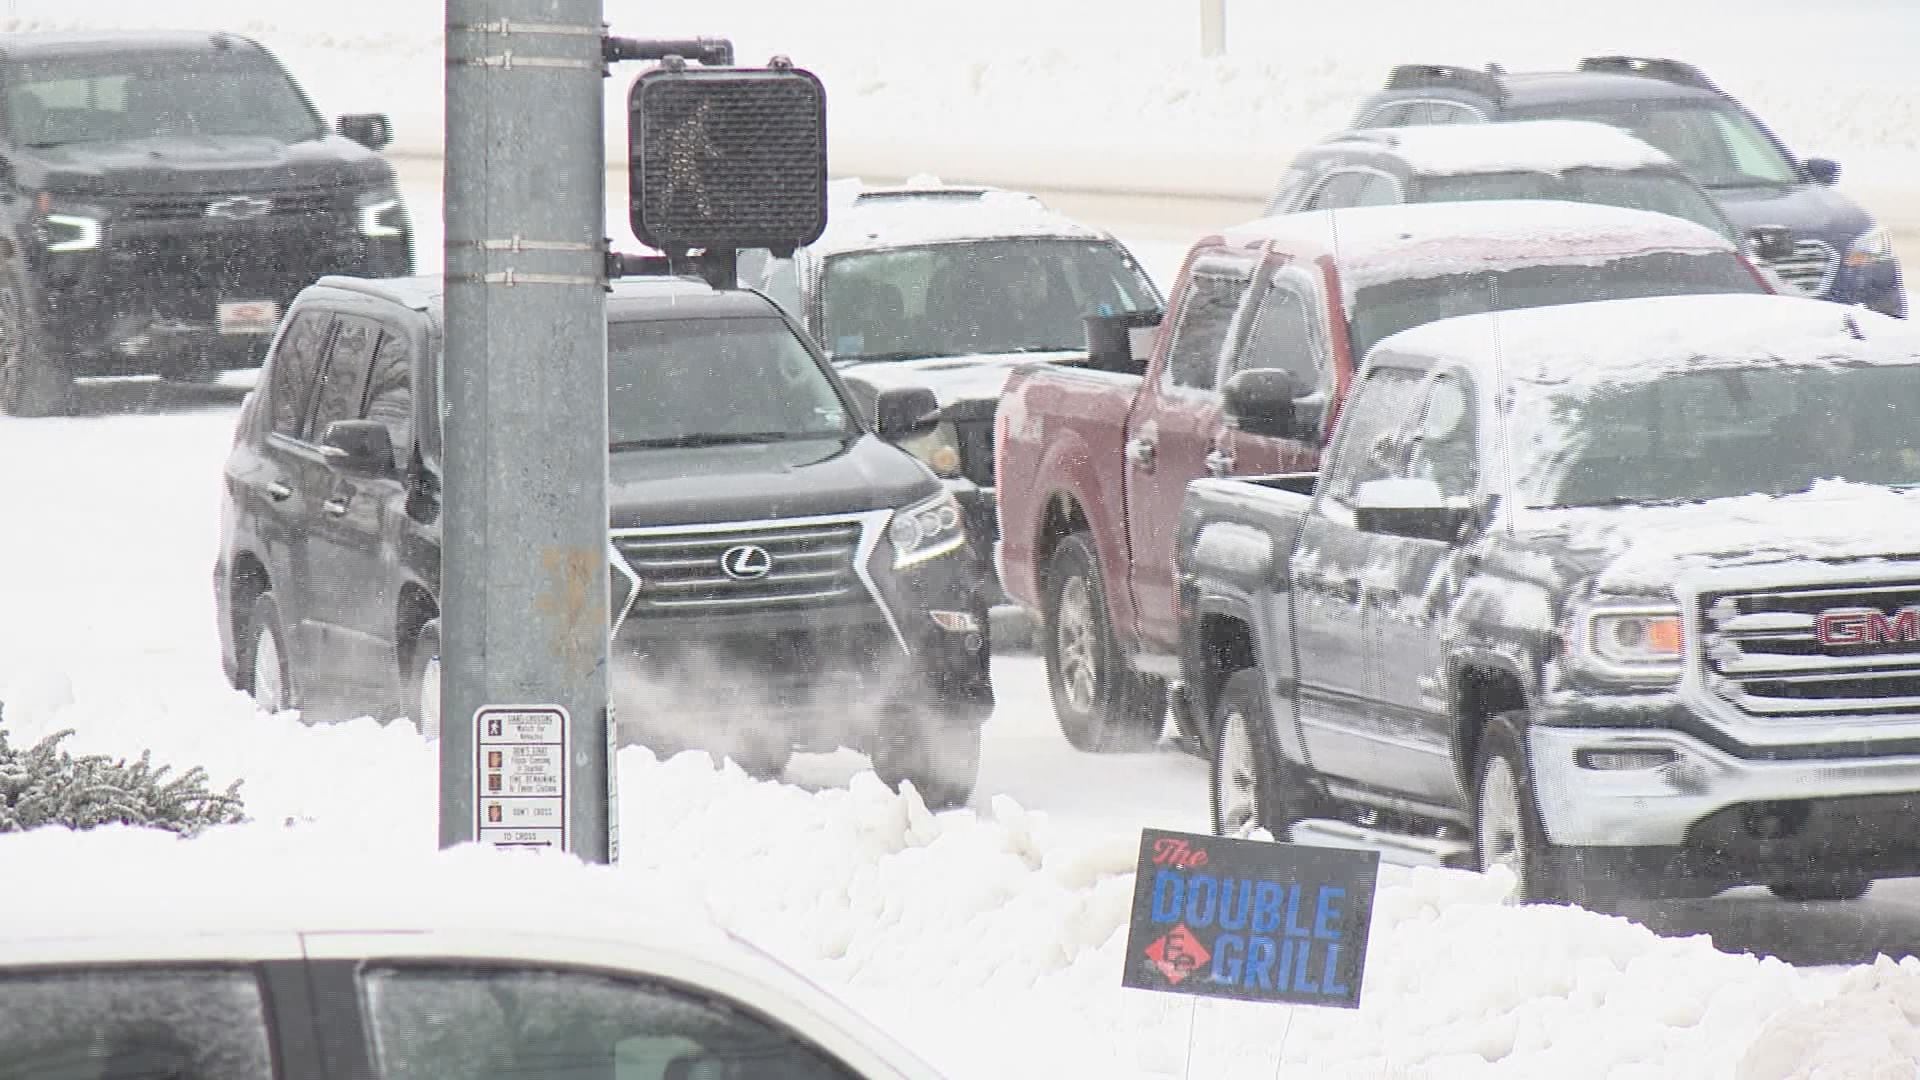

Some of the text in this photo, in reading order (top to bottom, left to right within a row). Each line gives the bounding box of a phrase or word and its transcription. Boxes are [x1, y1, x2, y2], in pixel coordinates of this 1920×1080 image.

[1815, 608, 1920, 645] GM
[1153, 838, 1208, 868] The
[1151, 868, 1345, 939] DOUBLE
[1211, 933, 1349, 994] GRILL
